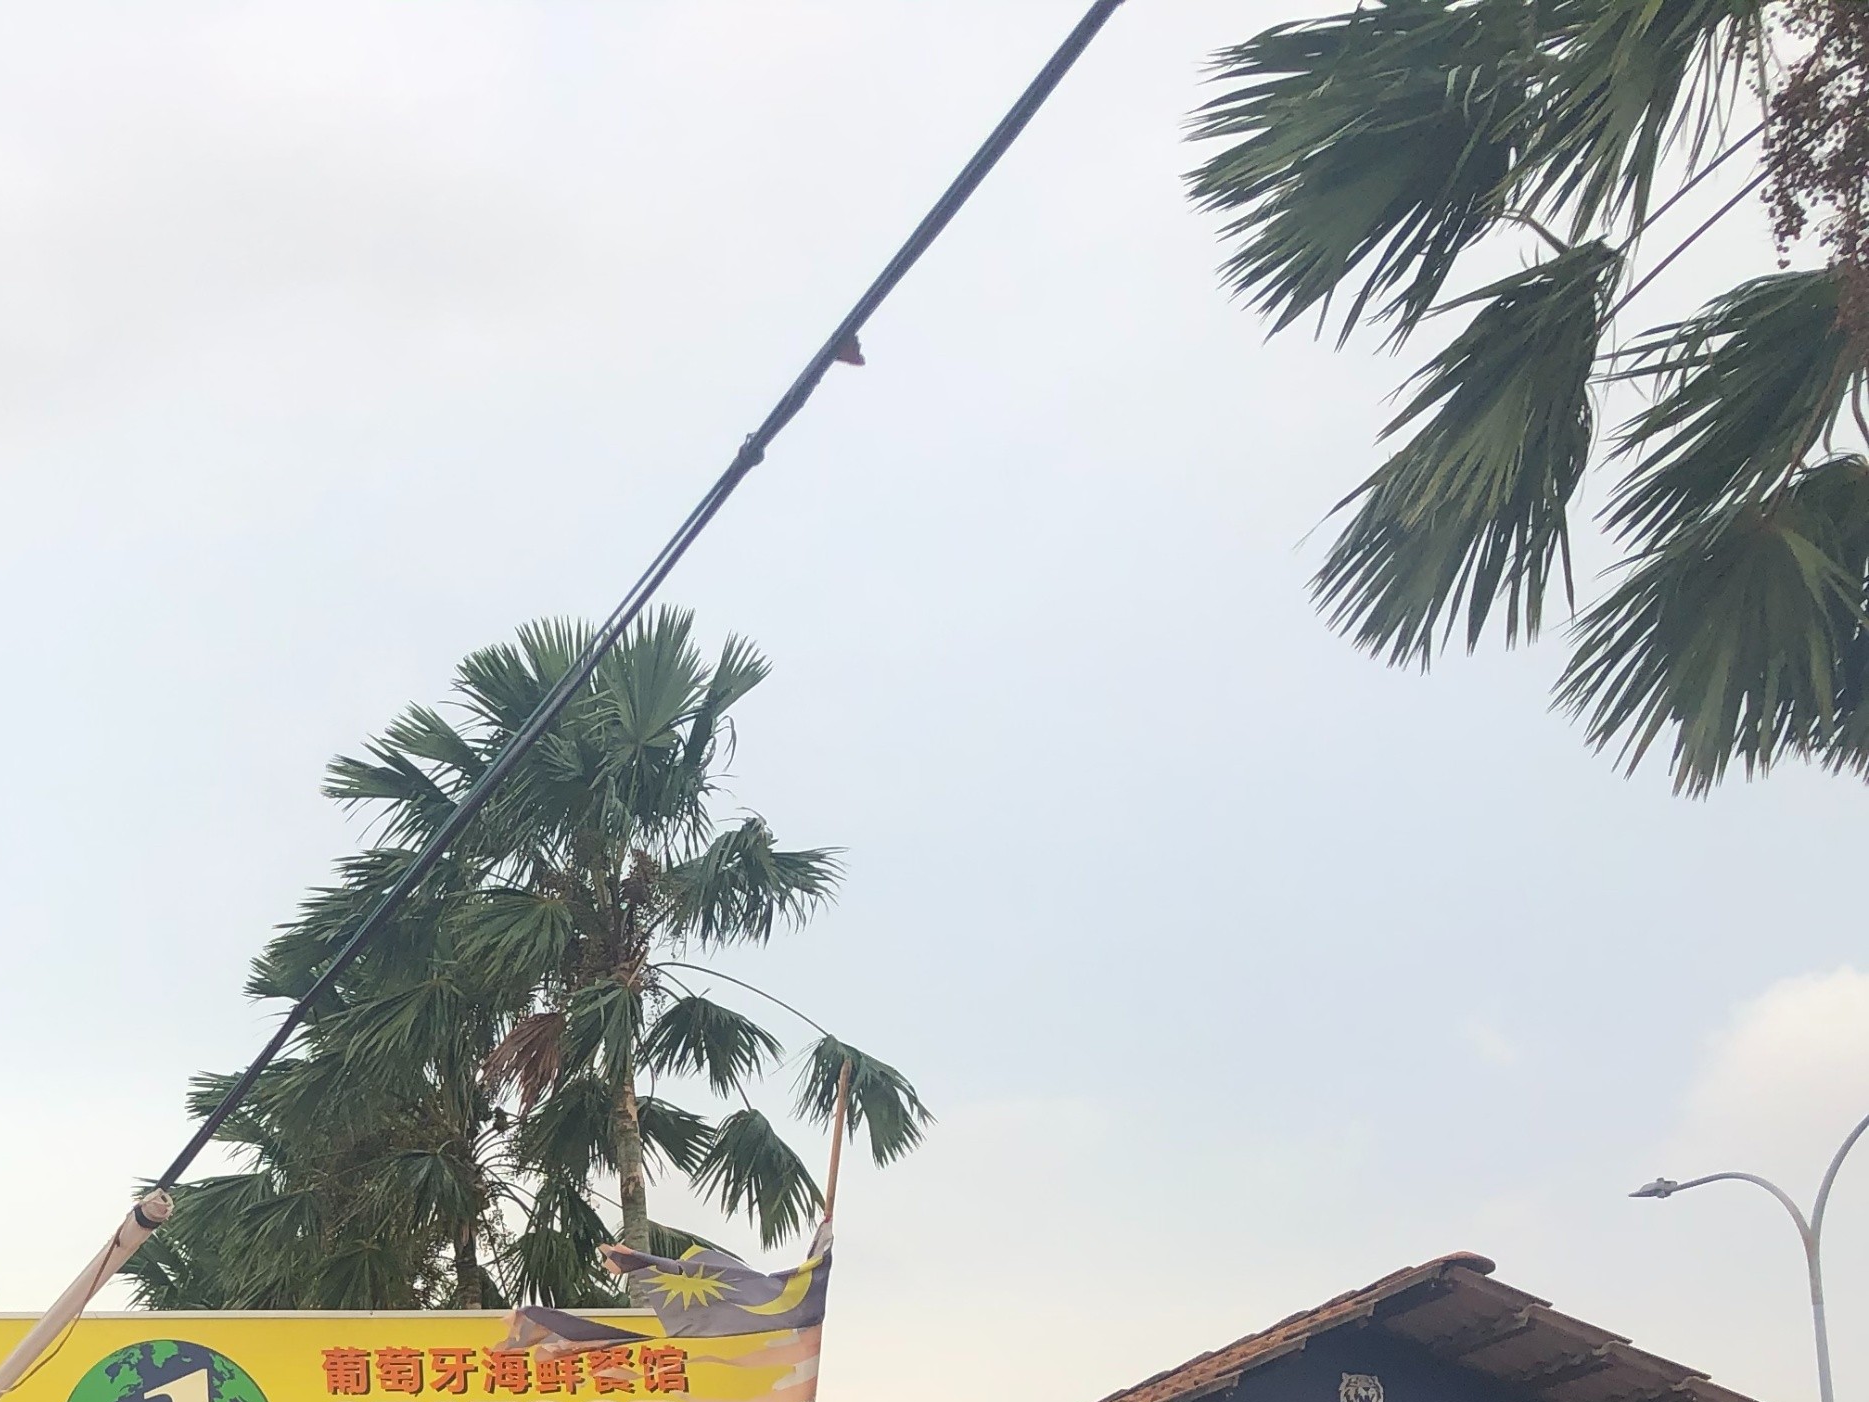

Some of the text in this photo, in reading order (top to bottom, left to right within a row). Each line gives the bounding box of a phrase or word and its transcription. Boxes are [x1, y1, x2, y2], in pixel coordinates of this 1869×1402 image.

[321, 1344, 691, 1397] 葡萄牙海鲜餐馆
